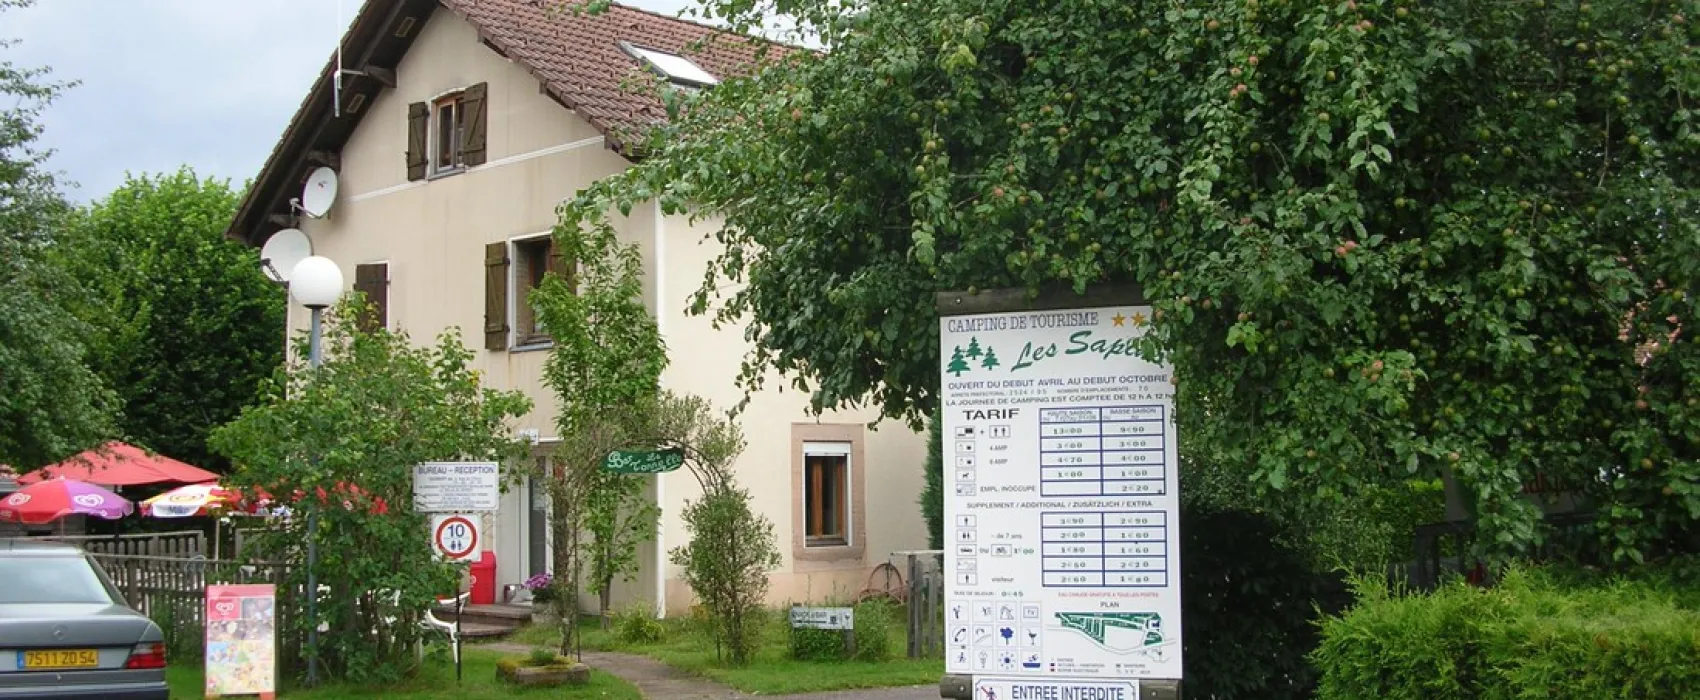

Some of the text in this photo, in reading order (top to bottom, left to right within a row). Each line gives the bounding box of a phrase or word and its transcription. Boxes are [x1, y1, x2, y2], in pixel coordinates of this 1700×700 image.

[948, 311, 1099, 333] CAMPING DE TOURISME
[1011, 341, 1058, 373] Les
[948, 374, 1168, 390] OUVERT DU DEBUT AVRIL AU DEBUT OCTOBRE
[945, 398, 956, 407] LA
[958, 398, 995, 407] JOURNEE
[1010, 396, 1050, 405] CAMPING
[1068, 394, 1112, 403] COMPTEE
[1113, 393, 1126, 401] DE
[963, 408, 1021, 421] TARIF
[418, 466, 447, 475] BUREAU
[454, 466, 494, 474] RECEPTION
[966, 502, 1015, 510] SUPPLEMENT
[1021, 501, 1066, 509] ADDITIONAL
[1126, 500, 1154, 508] EXTRA
[447, 523, 465, 538] 10
[27, 652, 58, 665] 7511
[79, 651, 95, 664] 54
[1012, 685, 1125, 700] ENTREE INTERDITE
